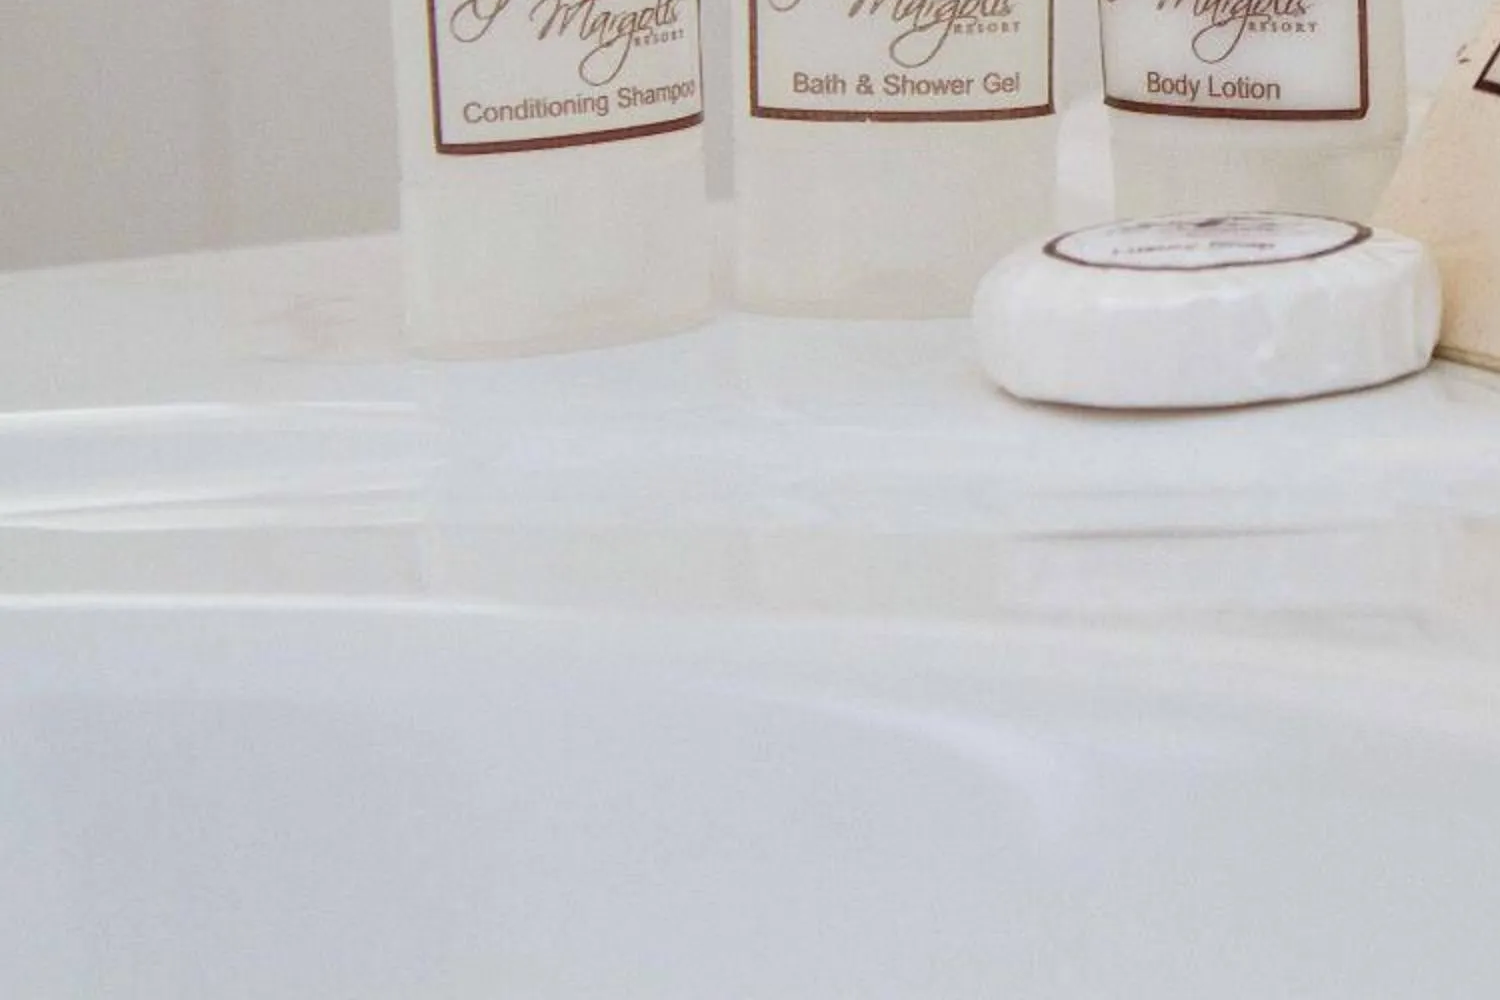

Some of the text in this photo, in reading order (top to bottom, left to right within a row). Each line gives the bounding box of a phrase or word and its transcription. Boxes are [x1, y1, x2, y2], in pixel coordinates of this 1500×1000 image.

[633, 27, 685, 48] RESORT
[953, 20, 1022, 35] RESORT
[1247, 21, 1319, 34] RESORT
[792, 71, 1021, 96] Bath & Shower Gel
[1147, 71, 1281, 101] Body Lotion
[462, 78, 696, 124] Conditioning Shampoo
